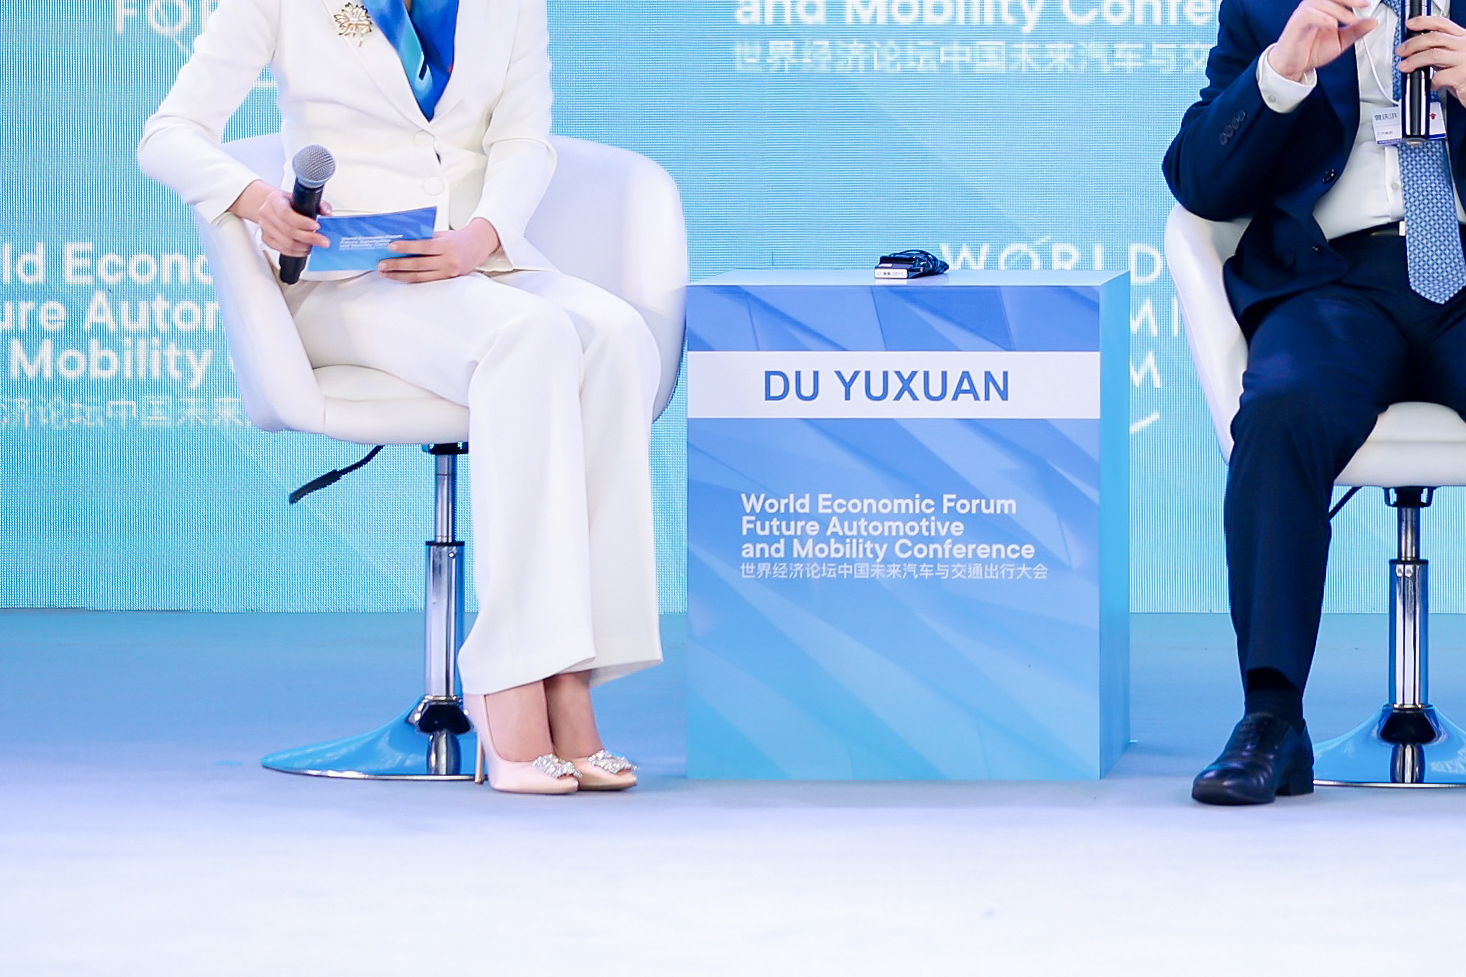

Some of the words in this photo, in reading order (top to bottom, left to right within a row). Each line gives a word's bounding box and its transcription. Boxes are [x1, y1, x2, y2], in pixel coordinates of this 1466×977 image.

[64, 242, 213, 285] Econo
[10, 336, 214, 391] Mobility
[764, 370, 820, 402] DU
[835, 370, 1009, 402] YUXUAN
[741, 493, 811, 514] World
[817, 493, 935, 514] Economic
[942, 493, 1018, 515] Forum
[742, 515, 821, 537] Future
[826, 515, 965, 537] Automotive
[741, 538, 785, 558] and
[793, 538, 888, 565] Mobility
[894, 537, 1035, 560] Conference
[741, 562, 1048, 580] 世界经济论坛中国未来汽车与交通出行大会
